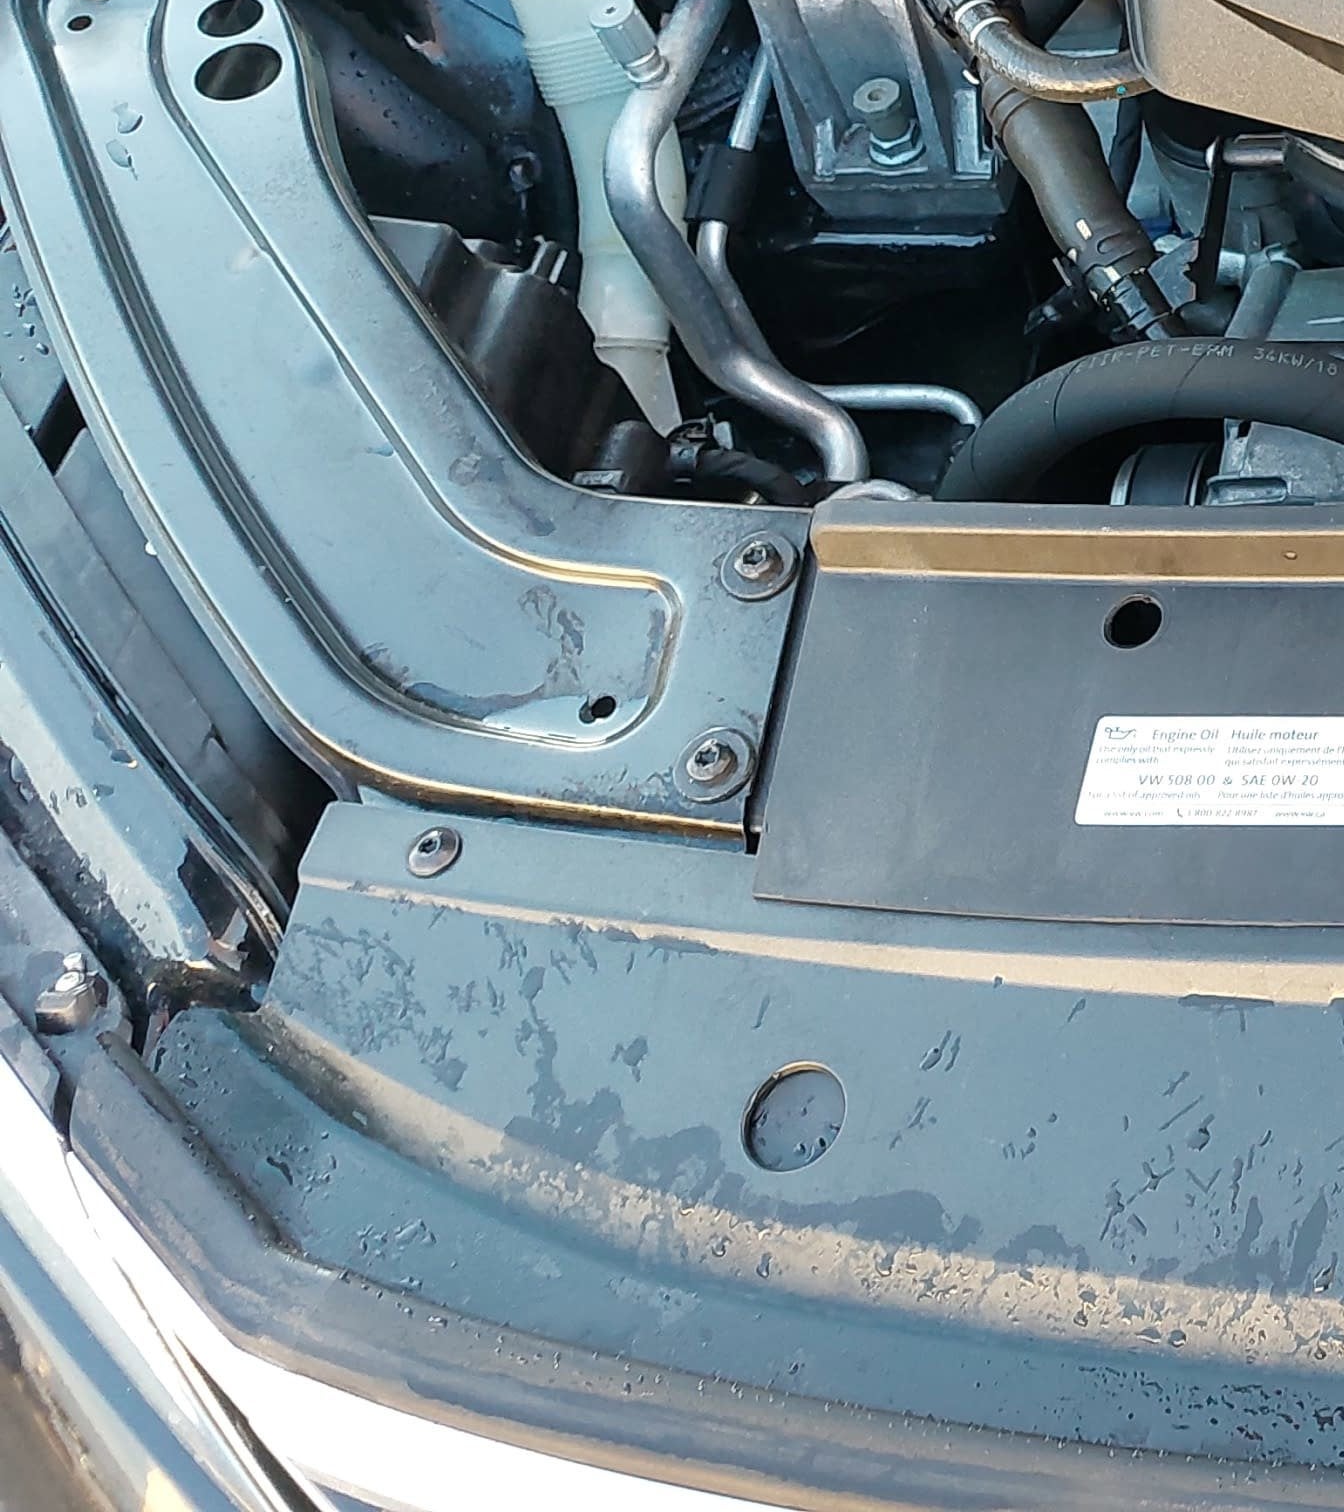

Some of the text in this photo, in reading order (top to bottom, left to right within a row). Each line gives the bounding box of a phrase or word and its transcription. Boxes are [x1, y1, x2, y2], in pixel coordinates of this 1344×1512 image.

[1152, 729, 1219, 743] Engine Oil
[1231, 730, 1319, 740] Huile moteur
[1138, 775, 1164, 785] VW
[1168, 775, 1192, 785] 508
[1197, 775, 1215, 785] 00
[1242, 775, 1266, 785] SAE
